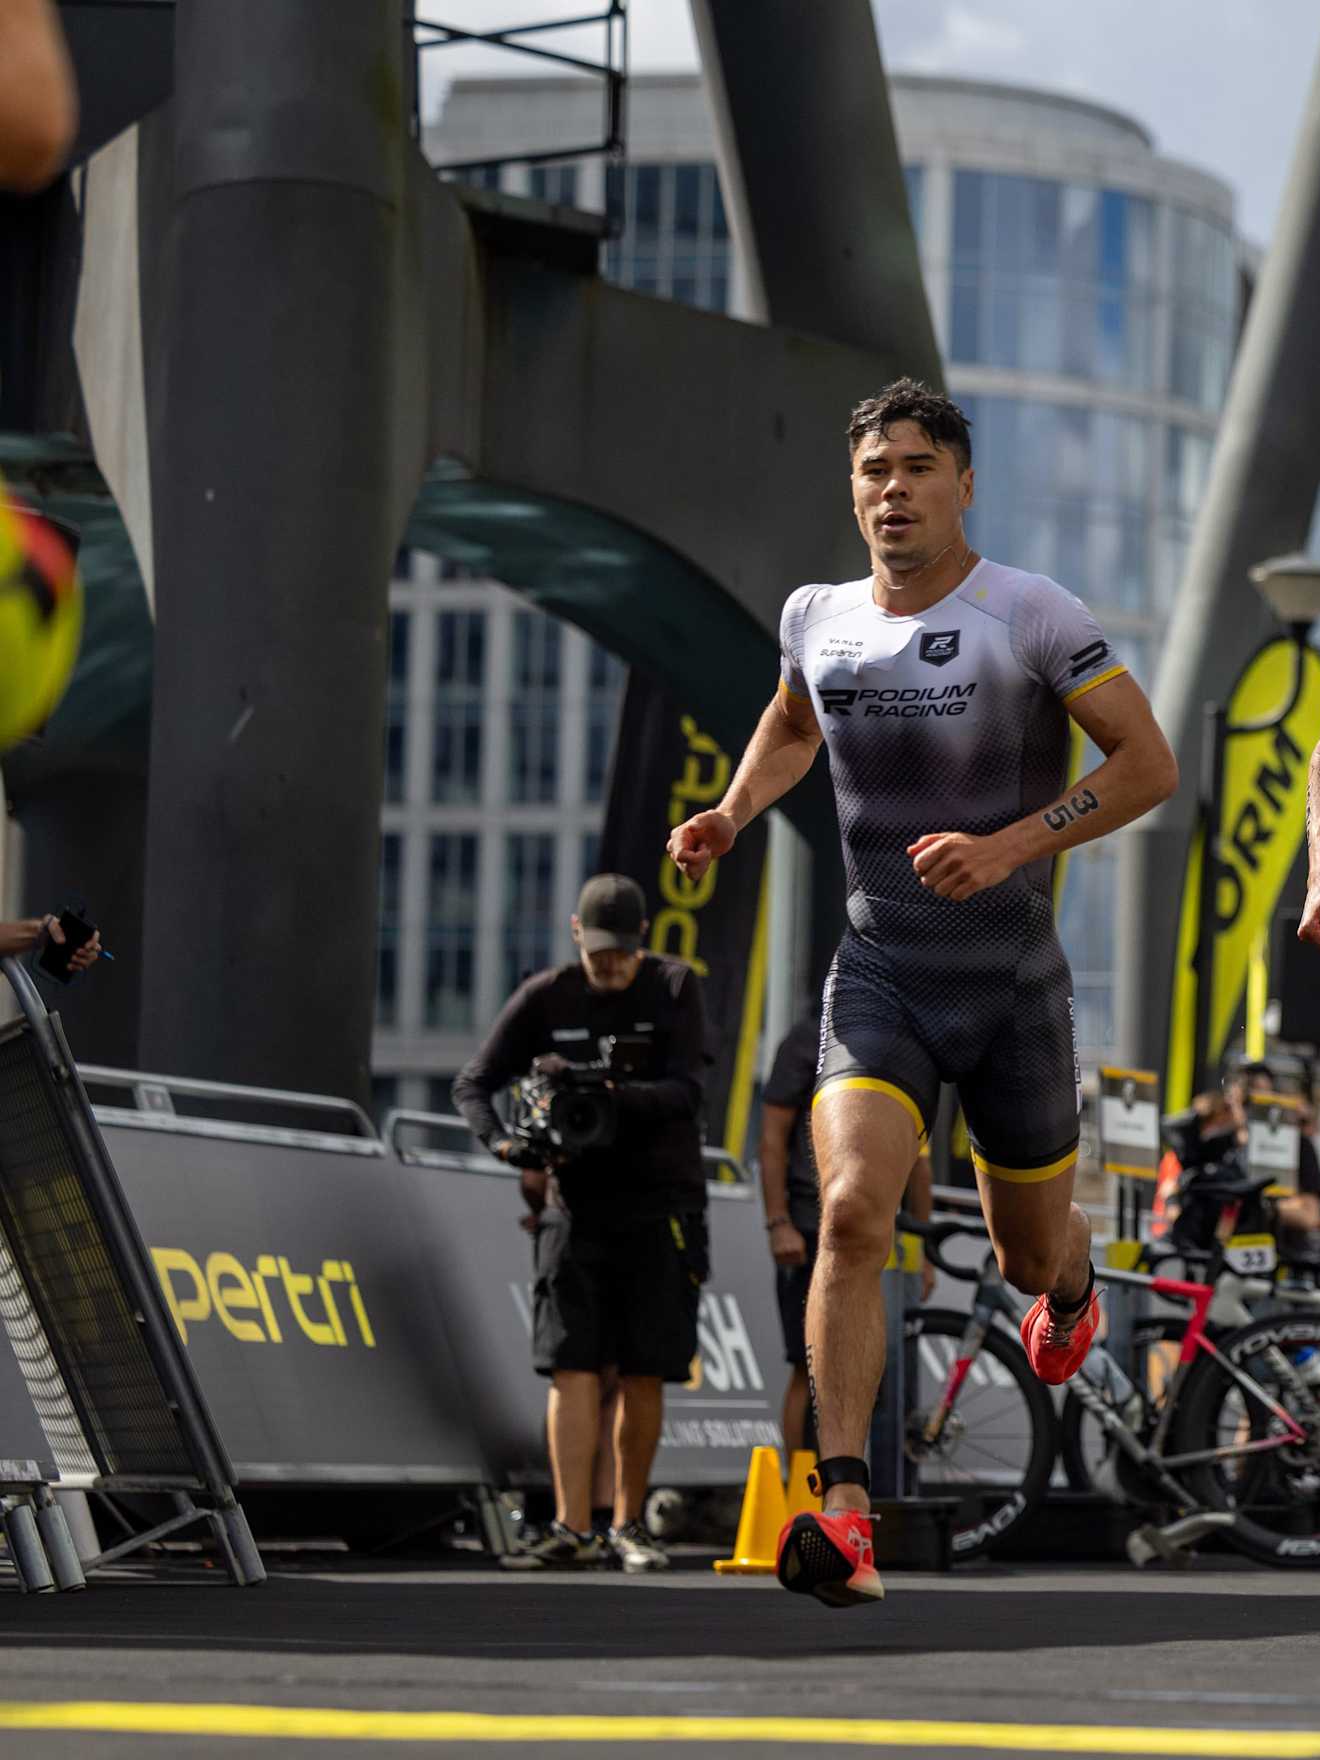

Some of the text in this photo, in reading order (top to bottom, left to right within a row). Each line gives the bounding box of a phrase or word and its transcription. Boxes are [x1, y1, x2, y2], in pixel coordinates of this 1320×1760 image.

[858, 682, 977, 702] PODIUM
[864, 701, 968, 718] RACING
[150, 1247, 376, 1348] pertri
